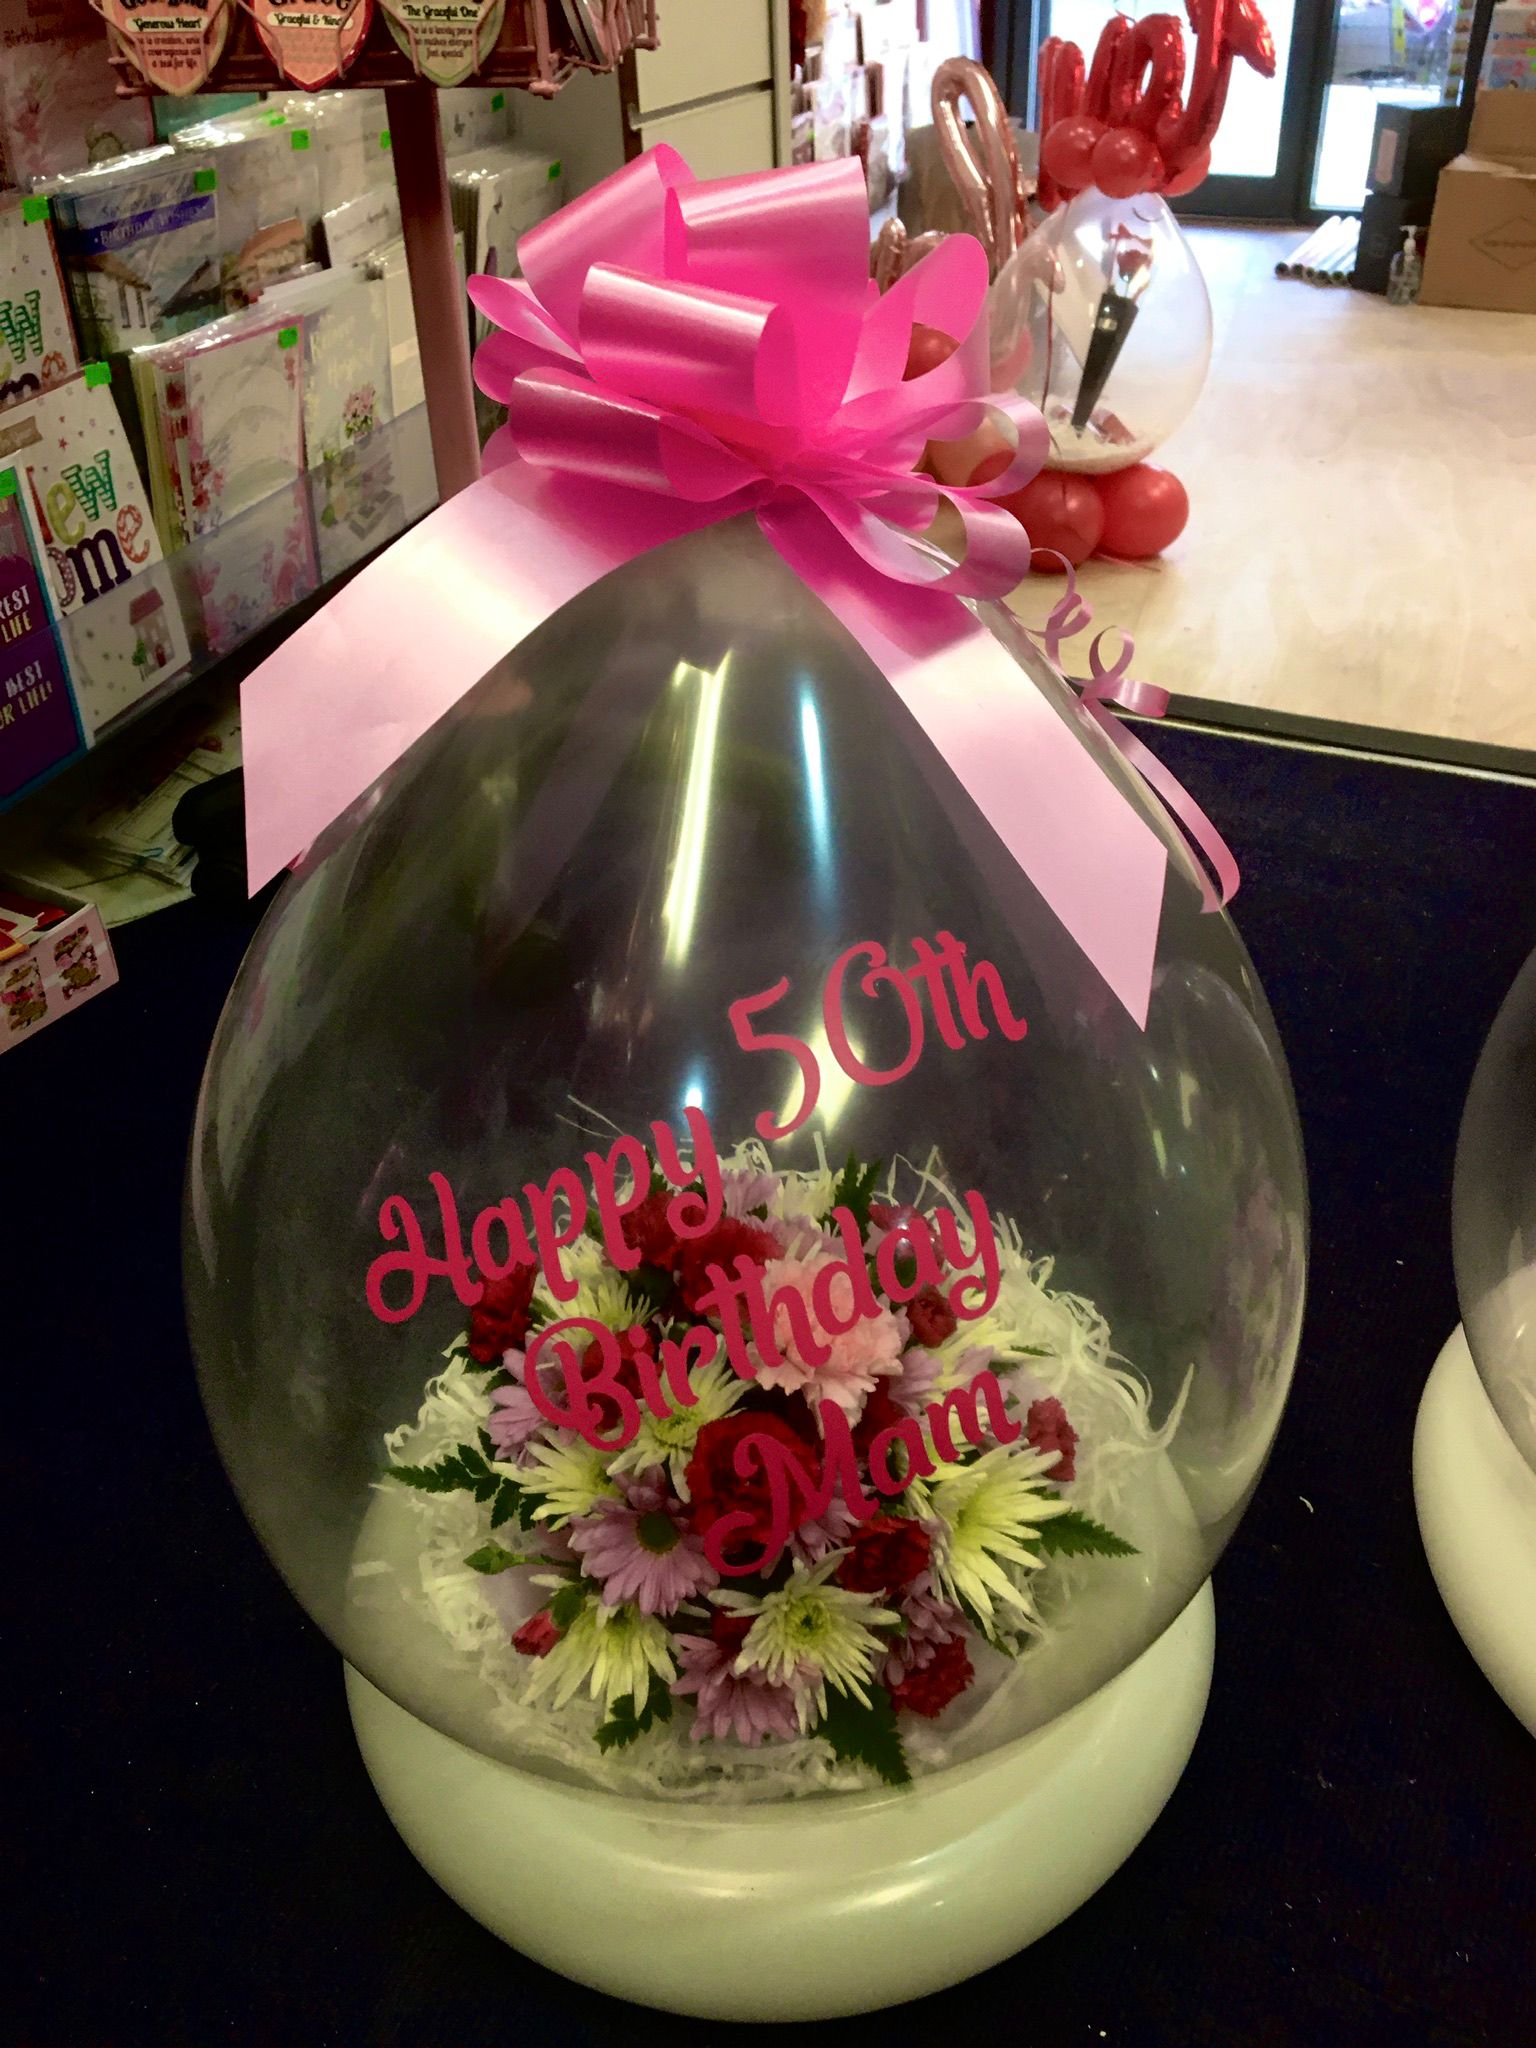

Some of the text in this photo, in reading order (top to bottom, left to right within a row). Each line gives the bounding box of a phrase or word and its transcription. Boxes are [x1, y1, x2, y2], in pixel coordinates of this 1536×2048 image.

[25, 449, 118, 546] ew
[365, 930, 1028, 1324] Happy 50th
[523, 1189, 1001, 1452] Birthday
[704, 1370, 1022, 1577] Mam
